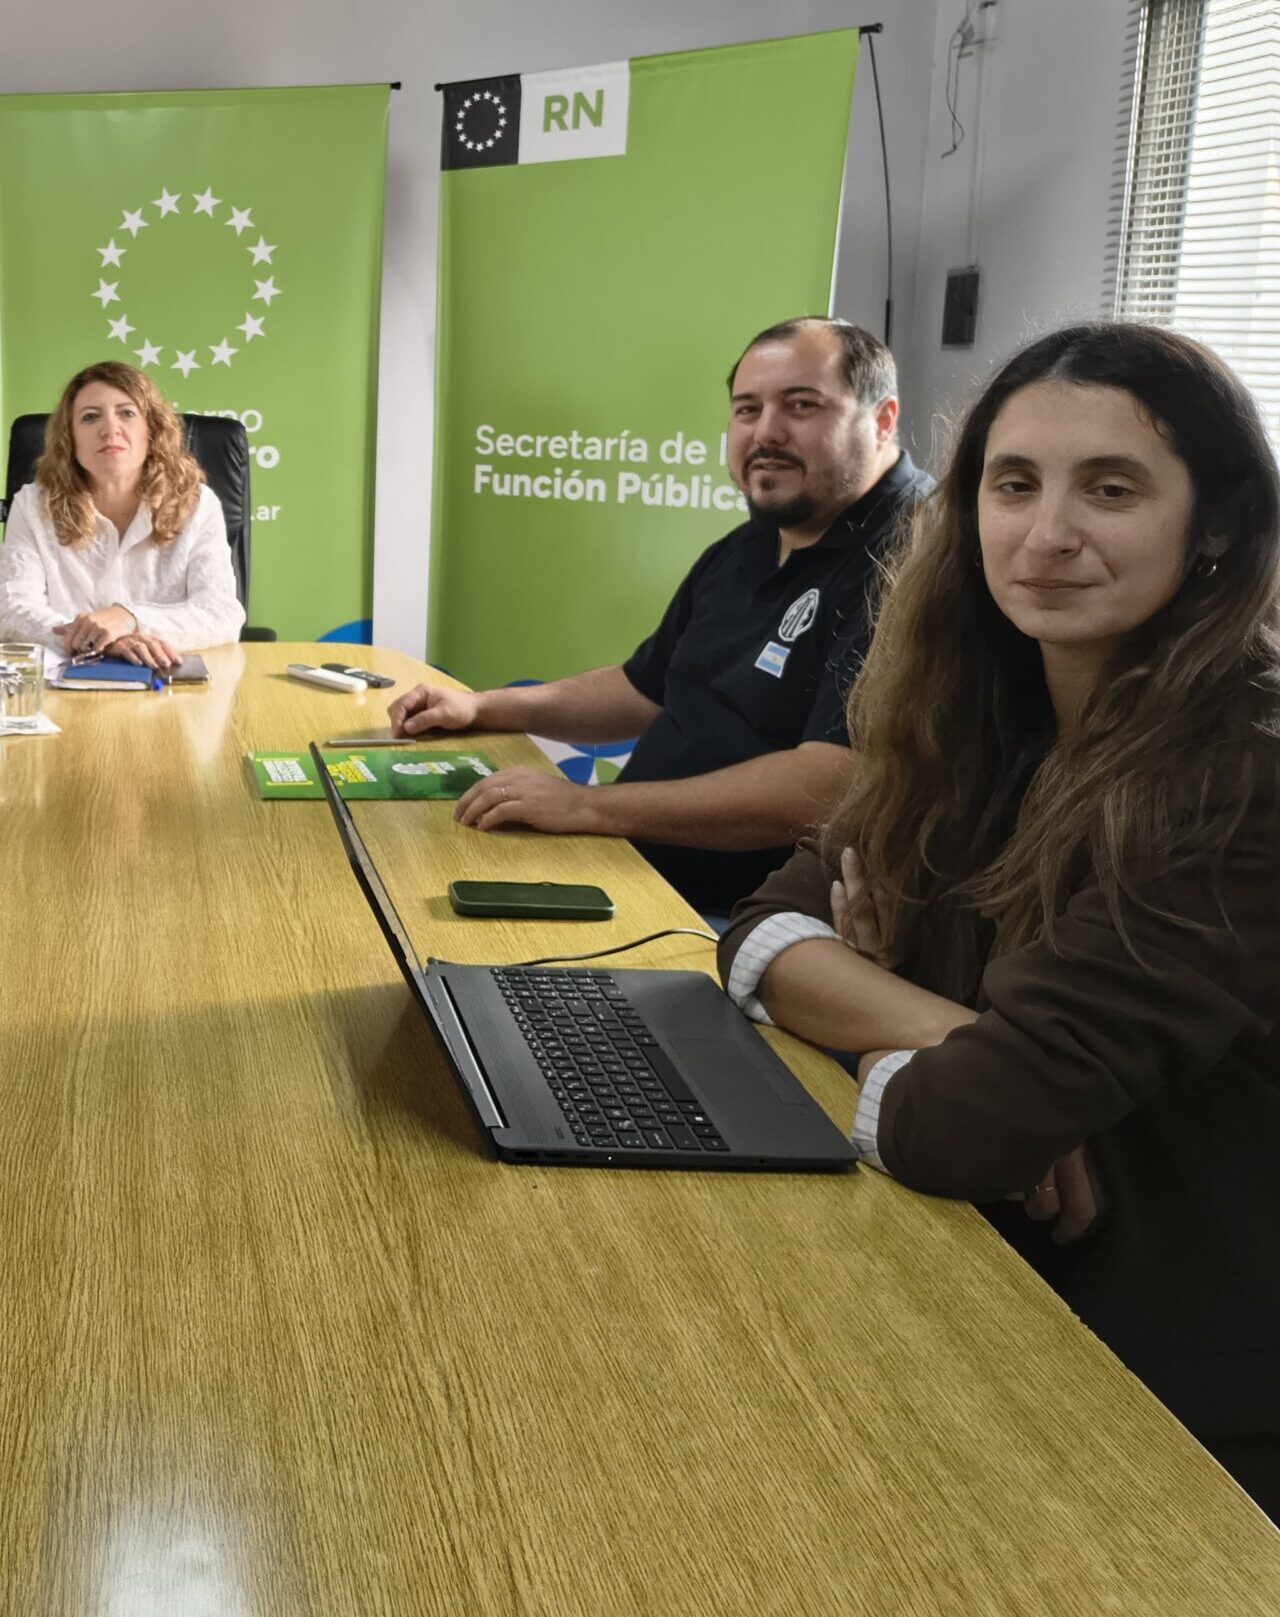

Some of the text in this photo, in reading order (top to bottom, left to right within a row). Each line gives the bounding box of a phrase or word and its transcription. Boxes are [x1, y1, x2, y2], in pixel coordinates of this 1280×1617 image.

[542, 89, 605, 133] RN
[475, 424, 648, 462] Secretaría
[659, 431, 708, 466] de
[474, 464, 607, 502] Función
